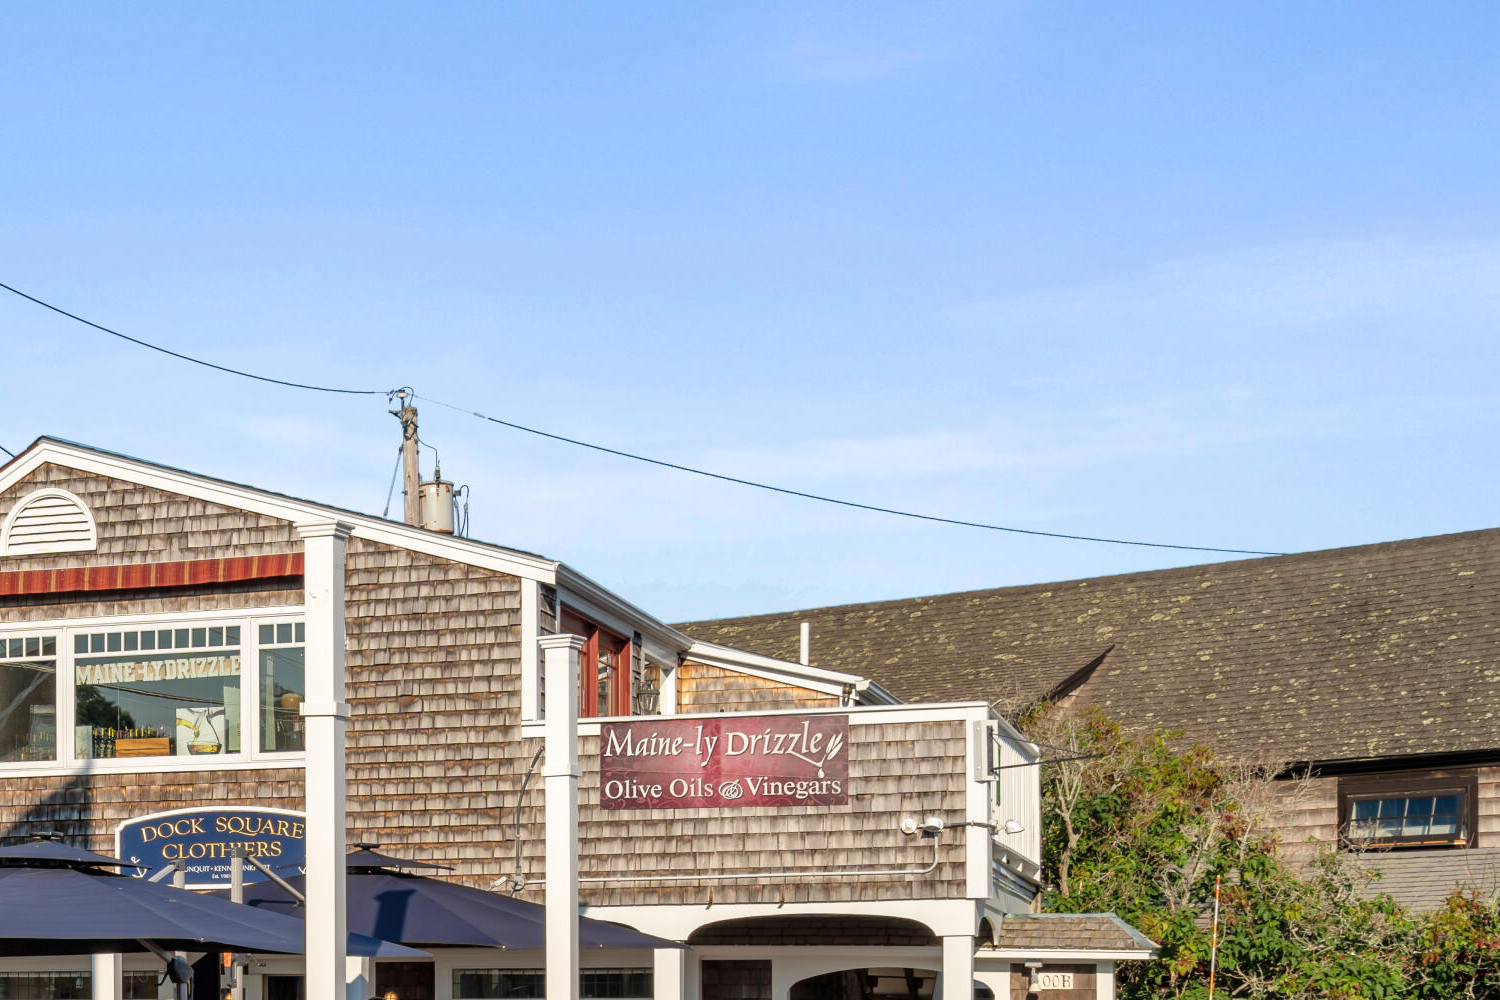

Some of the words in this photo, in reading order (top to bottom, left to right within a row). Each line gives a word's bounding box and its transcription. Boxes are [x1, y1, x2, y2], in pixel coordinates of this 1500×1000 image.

[604, 726, 718, 766] Maine-ly
[725, 721, 825, 766] Drizzle
[605, 779, 663, 799] Olive
[669, 778, 714, 798] Oils
[745, 777, 842, 799] Vinegars
[141, 817, 206, 843] DOCK
[215, 815, 305, 840] SQUARE
